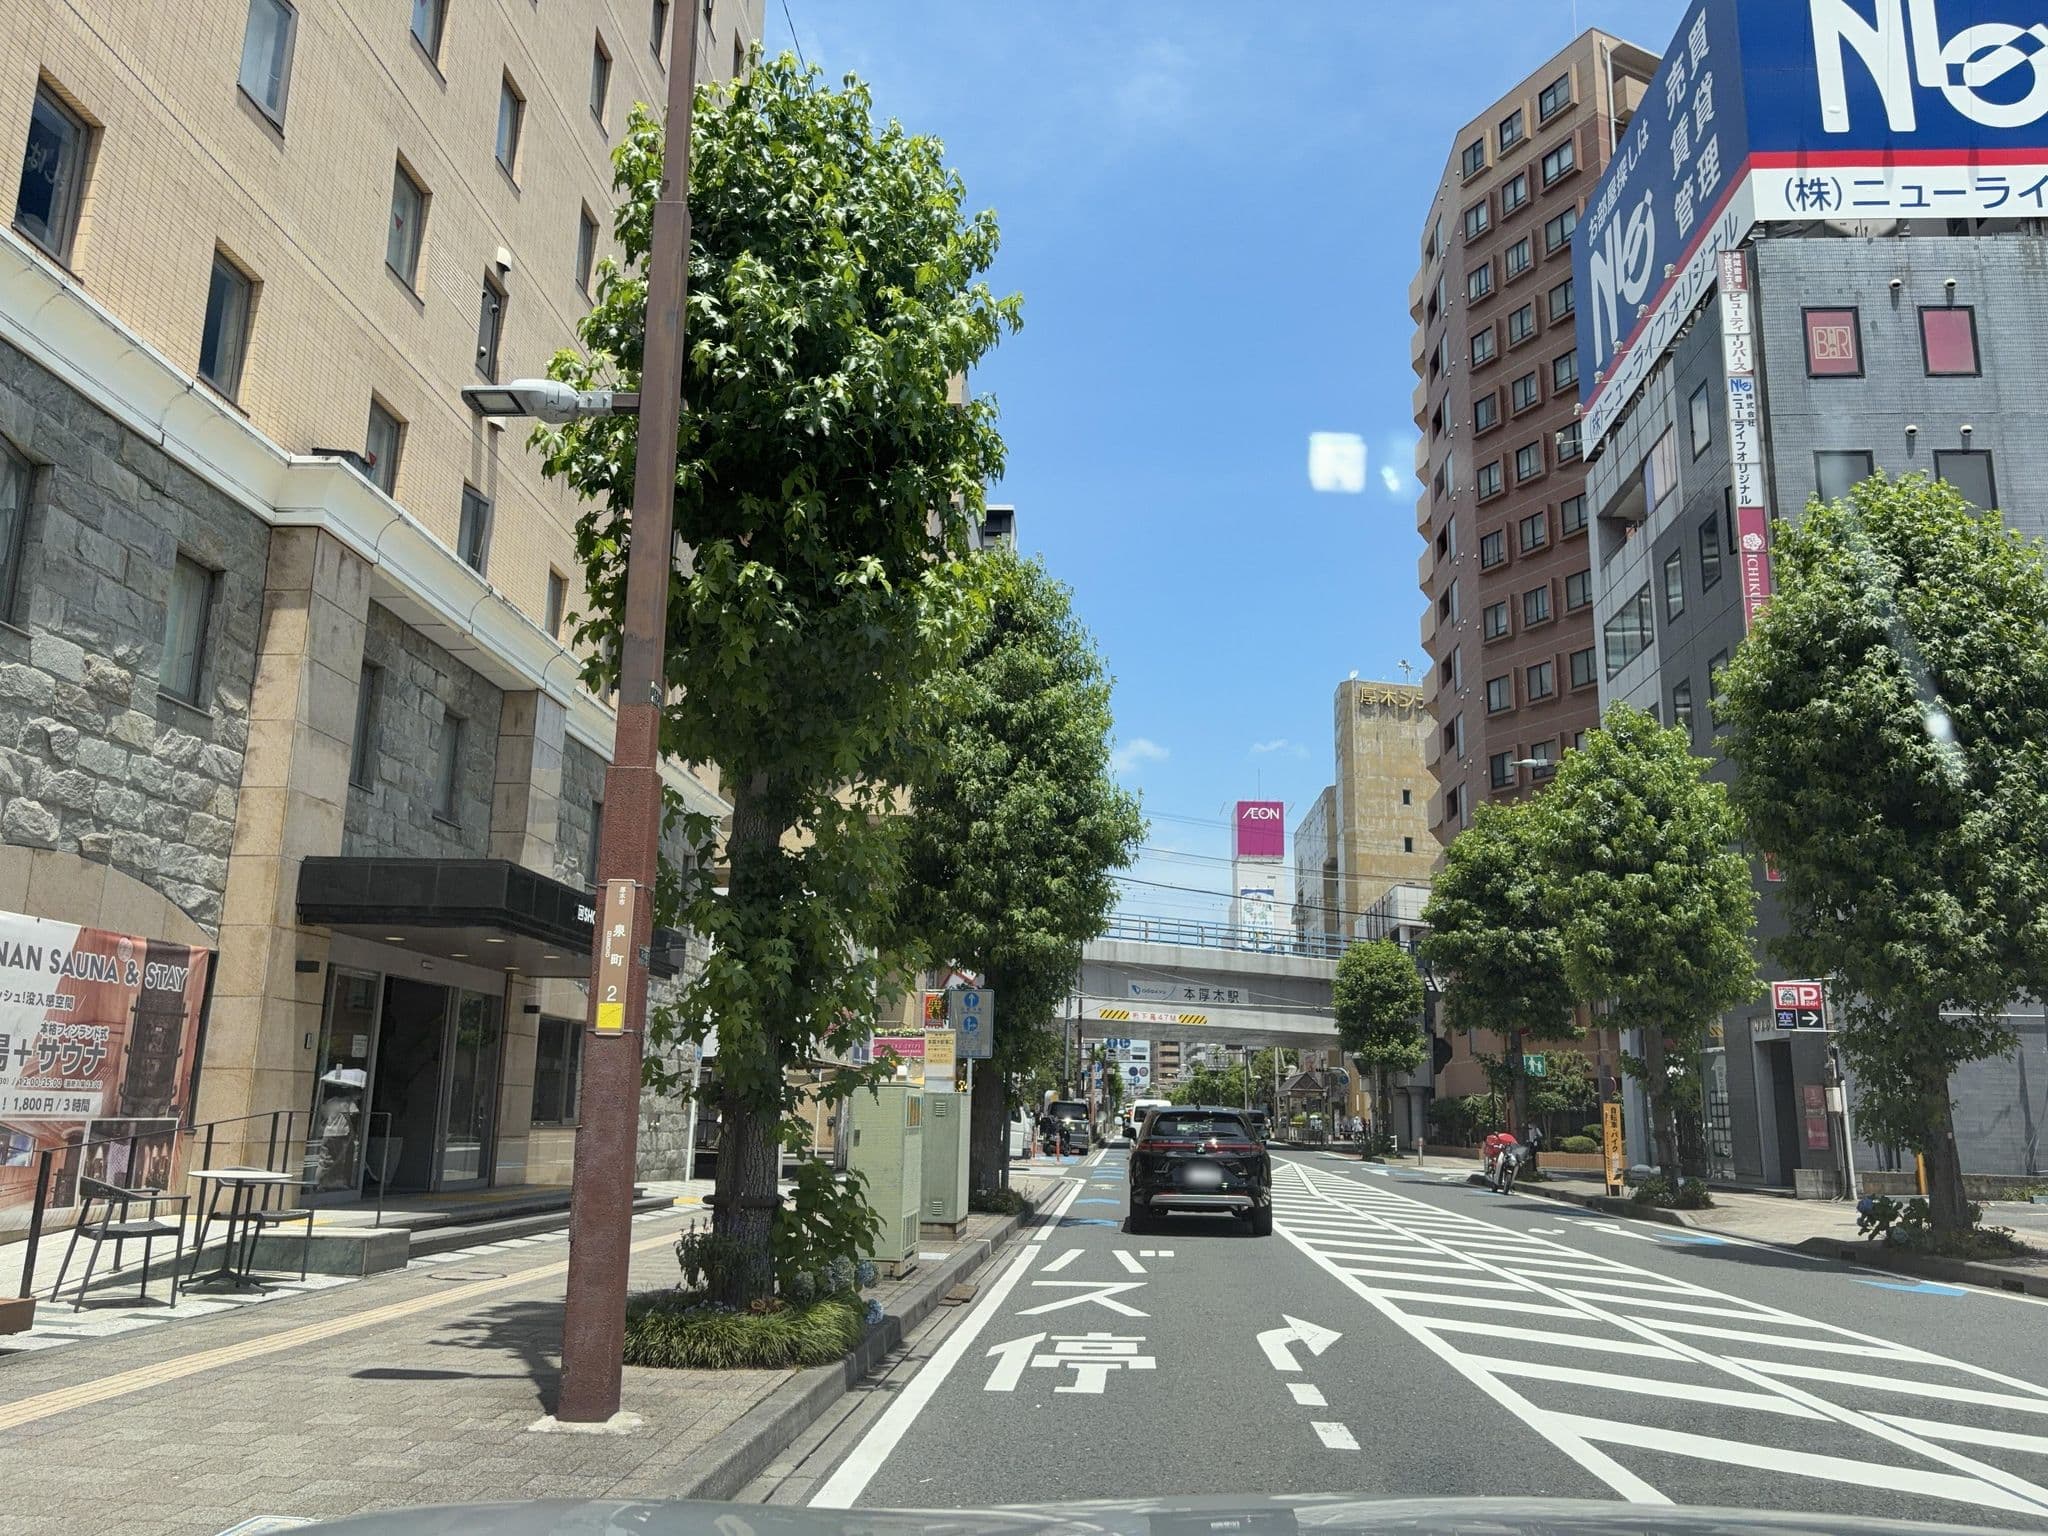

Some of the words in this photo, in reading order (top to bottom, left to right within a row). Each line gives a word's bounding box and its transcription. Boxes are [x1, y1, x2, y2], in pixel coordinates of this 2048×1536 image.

[1588, 119, 1649, 247] お部屋探しは
[1732, 393, 1752, 505] ニューライフオリジナル
[49, 948, 120, 984] SAUNA
[124, 959, 140, 986] &
[144, 962, 190, 992] STAY
[606, 985, 617, 1002] 2
[1183, 986, 1240, 1004] 本厚木駅
[1800, 987, 1818, 1006] P
[1777, 1012, 1795, 1027] 空
[40, 1022, 109, 1040] 本格フィンランド式
